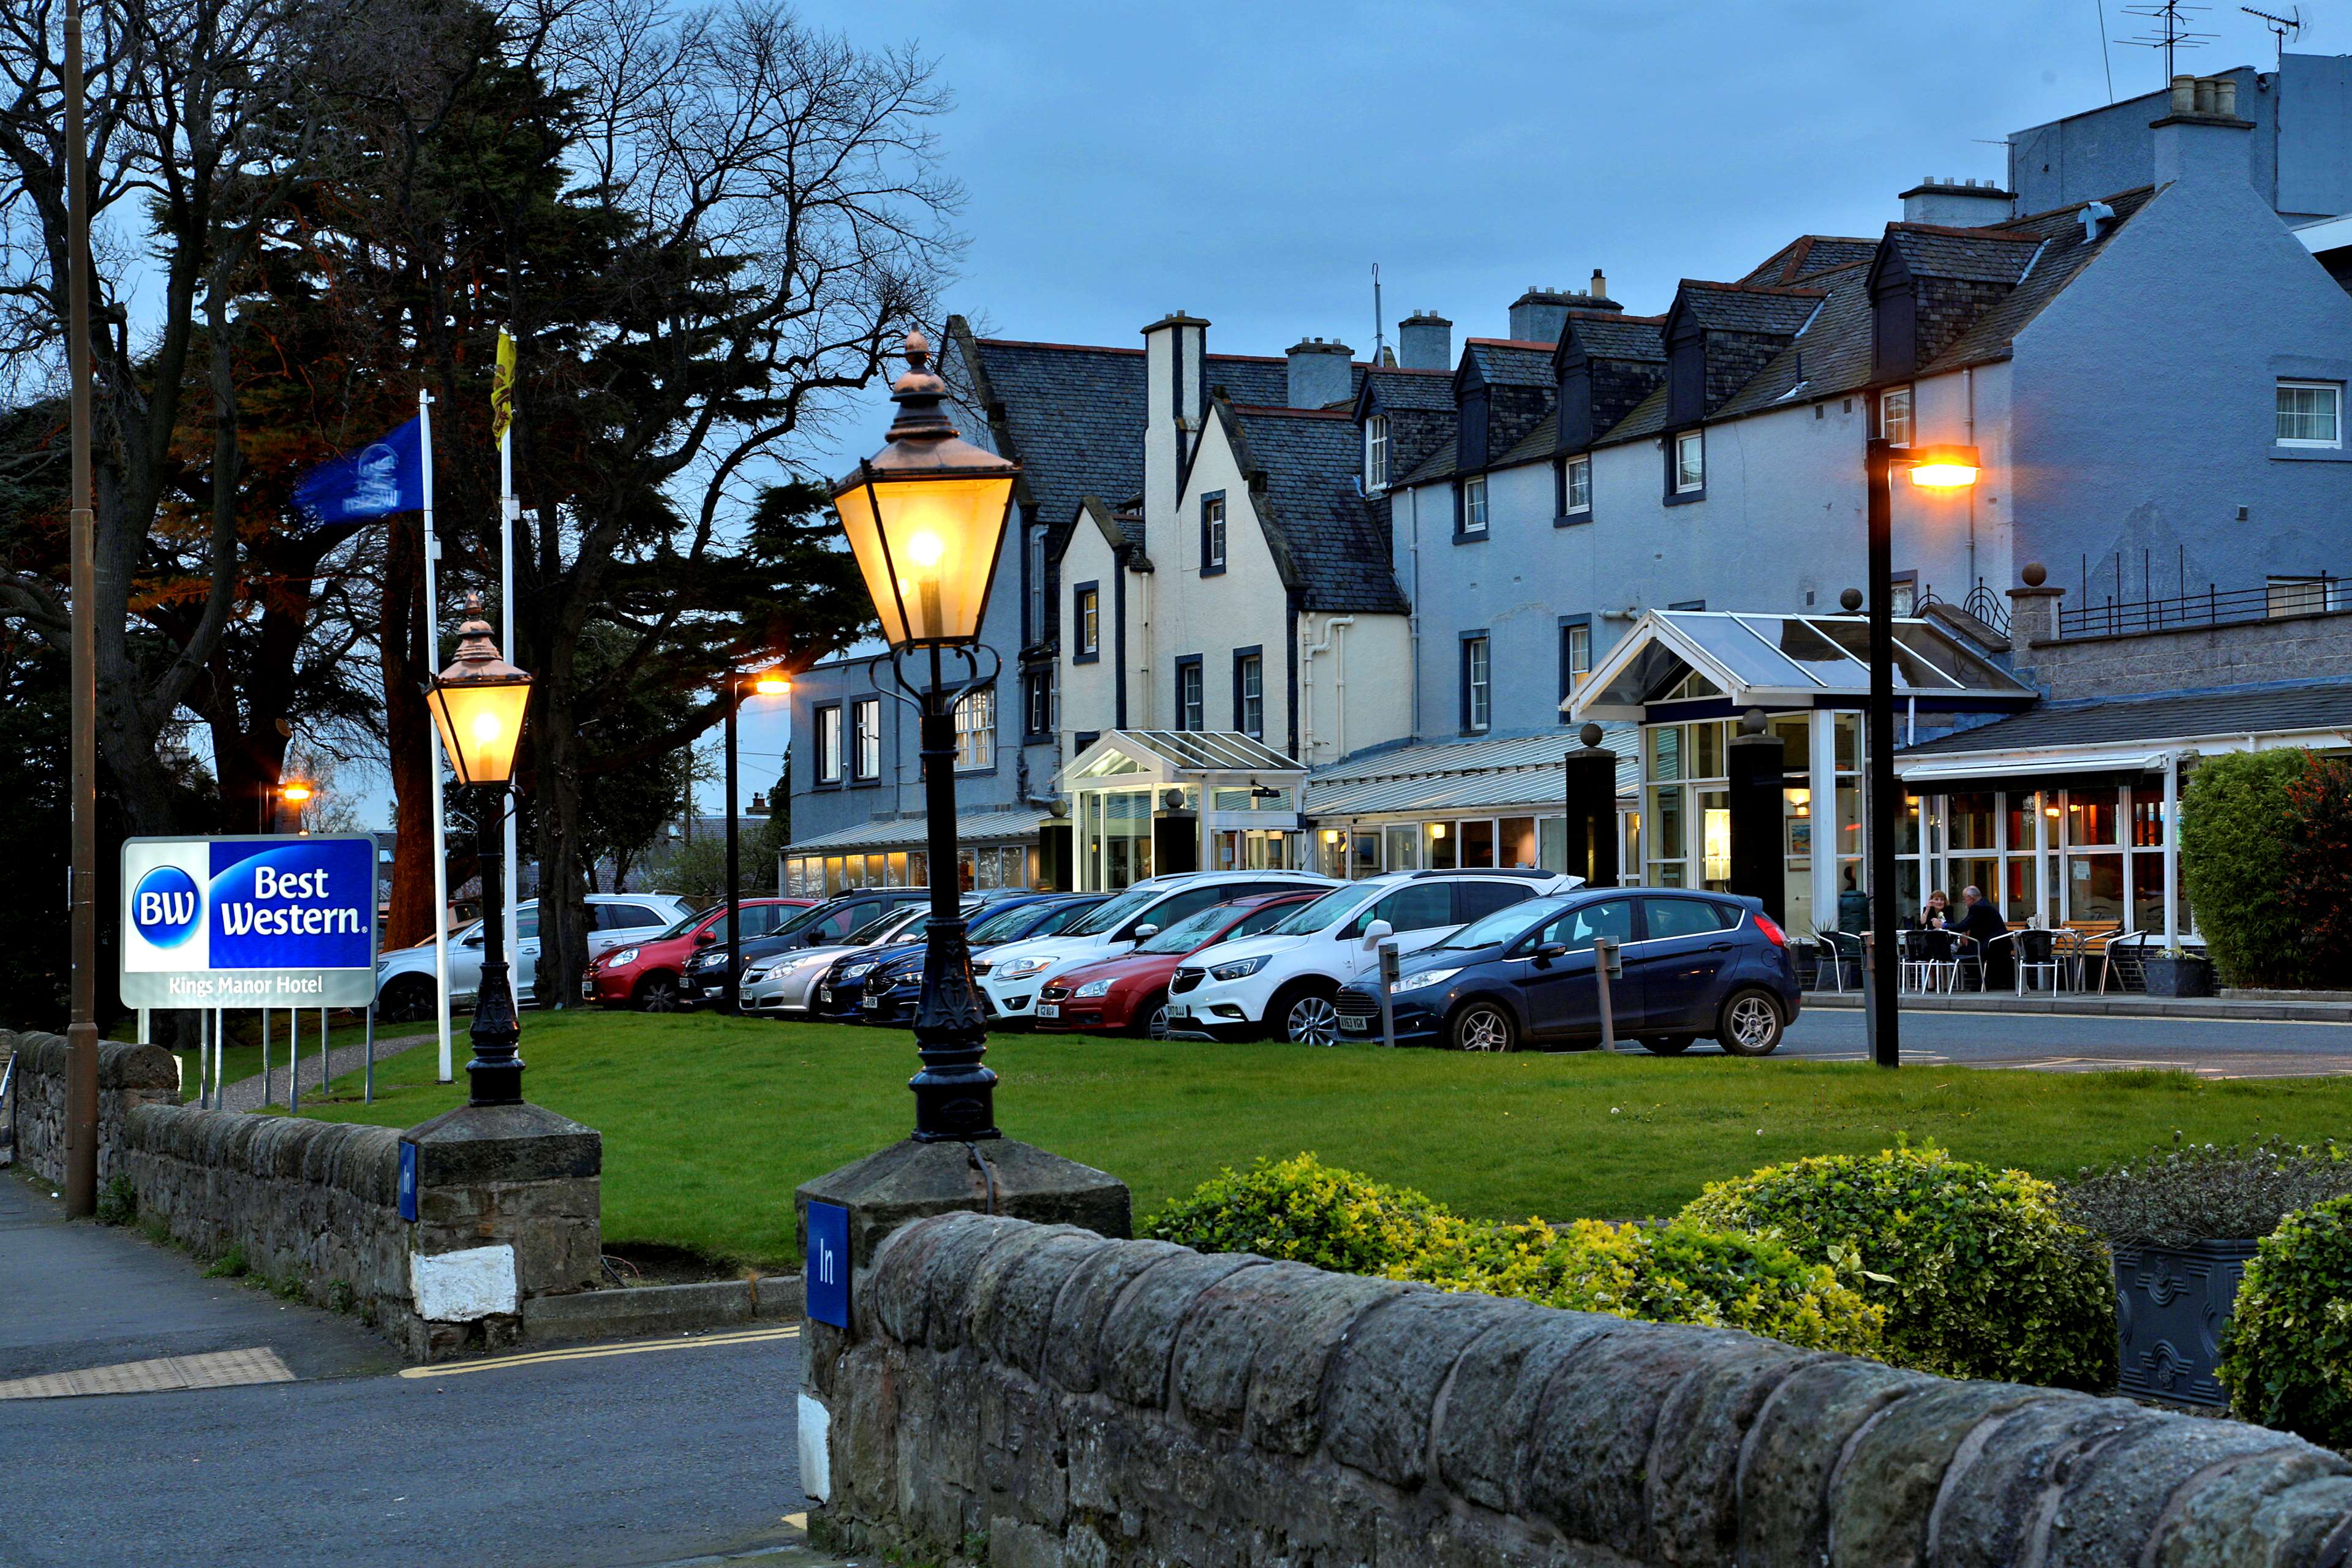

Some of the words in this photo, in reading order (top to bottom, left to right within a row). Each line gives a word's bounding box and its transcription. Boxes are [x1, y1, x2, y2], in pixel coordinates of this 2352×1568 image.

[255, 866, 329, 899] Best
[140, 891, 194, 925] BW
[169, 976, 214, 998] Kings
[218, 976, 272, 993] Manor
[276, 975, 323, 993] Hotel
[820, 1238, 834, 1285] In
